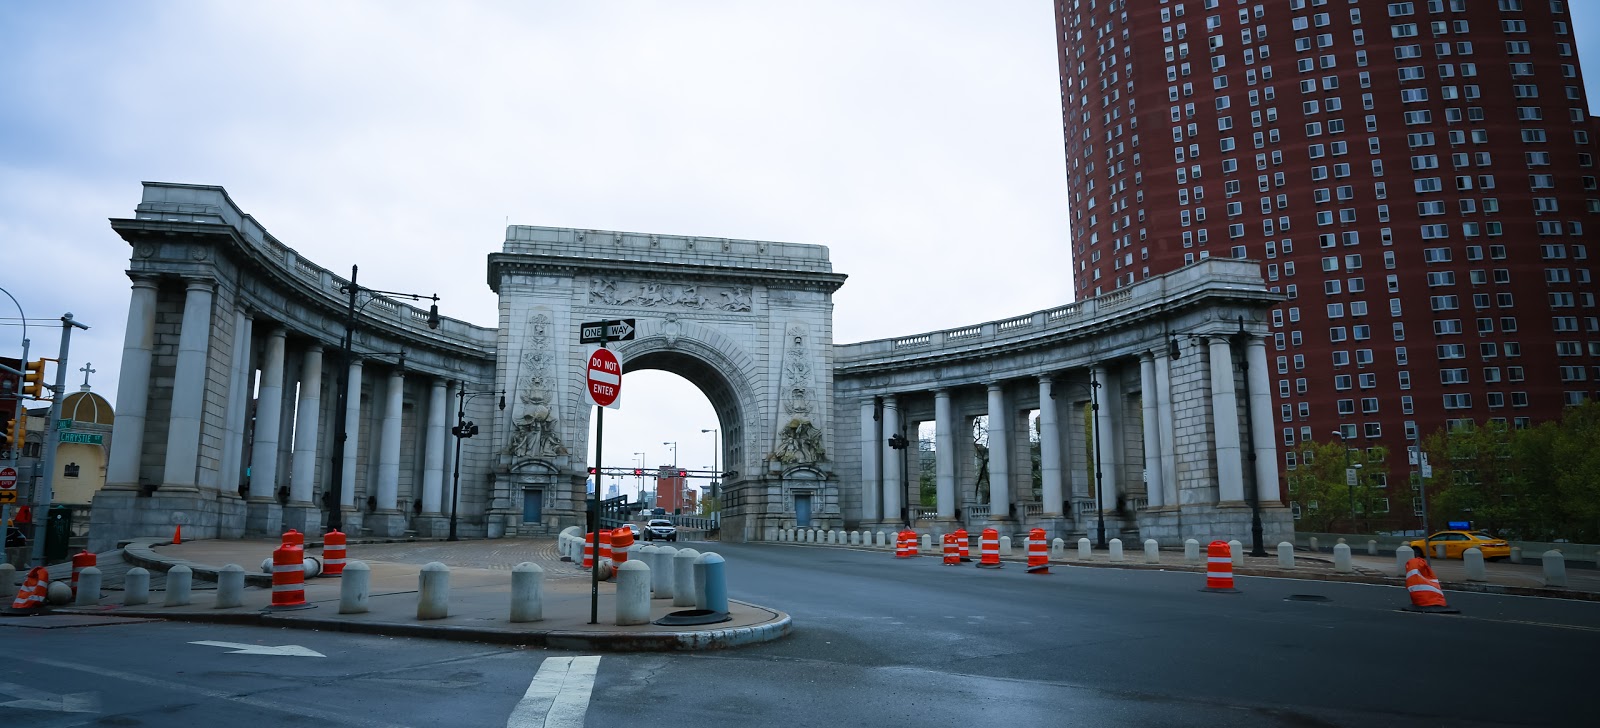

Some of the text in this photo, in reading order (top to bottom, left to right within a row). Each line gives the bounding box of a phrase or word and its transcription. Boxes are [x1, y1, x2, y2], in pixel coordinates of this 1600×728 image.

[585, 326, 629, 338] ONE WAY
[592, 357, 617, 371] DO NOT
[593, 383, 613, 396] ENTER
[61, 432, 91, 442] CHRYSTIE
